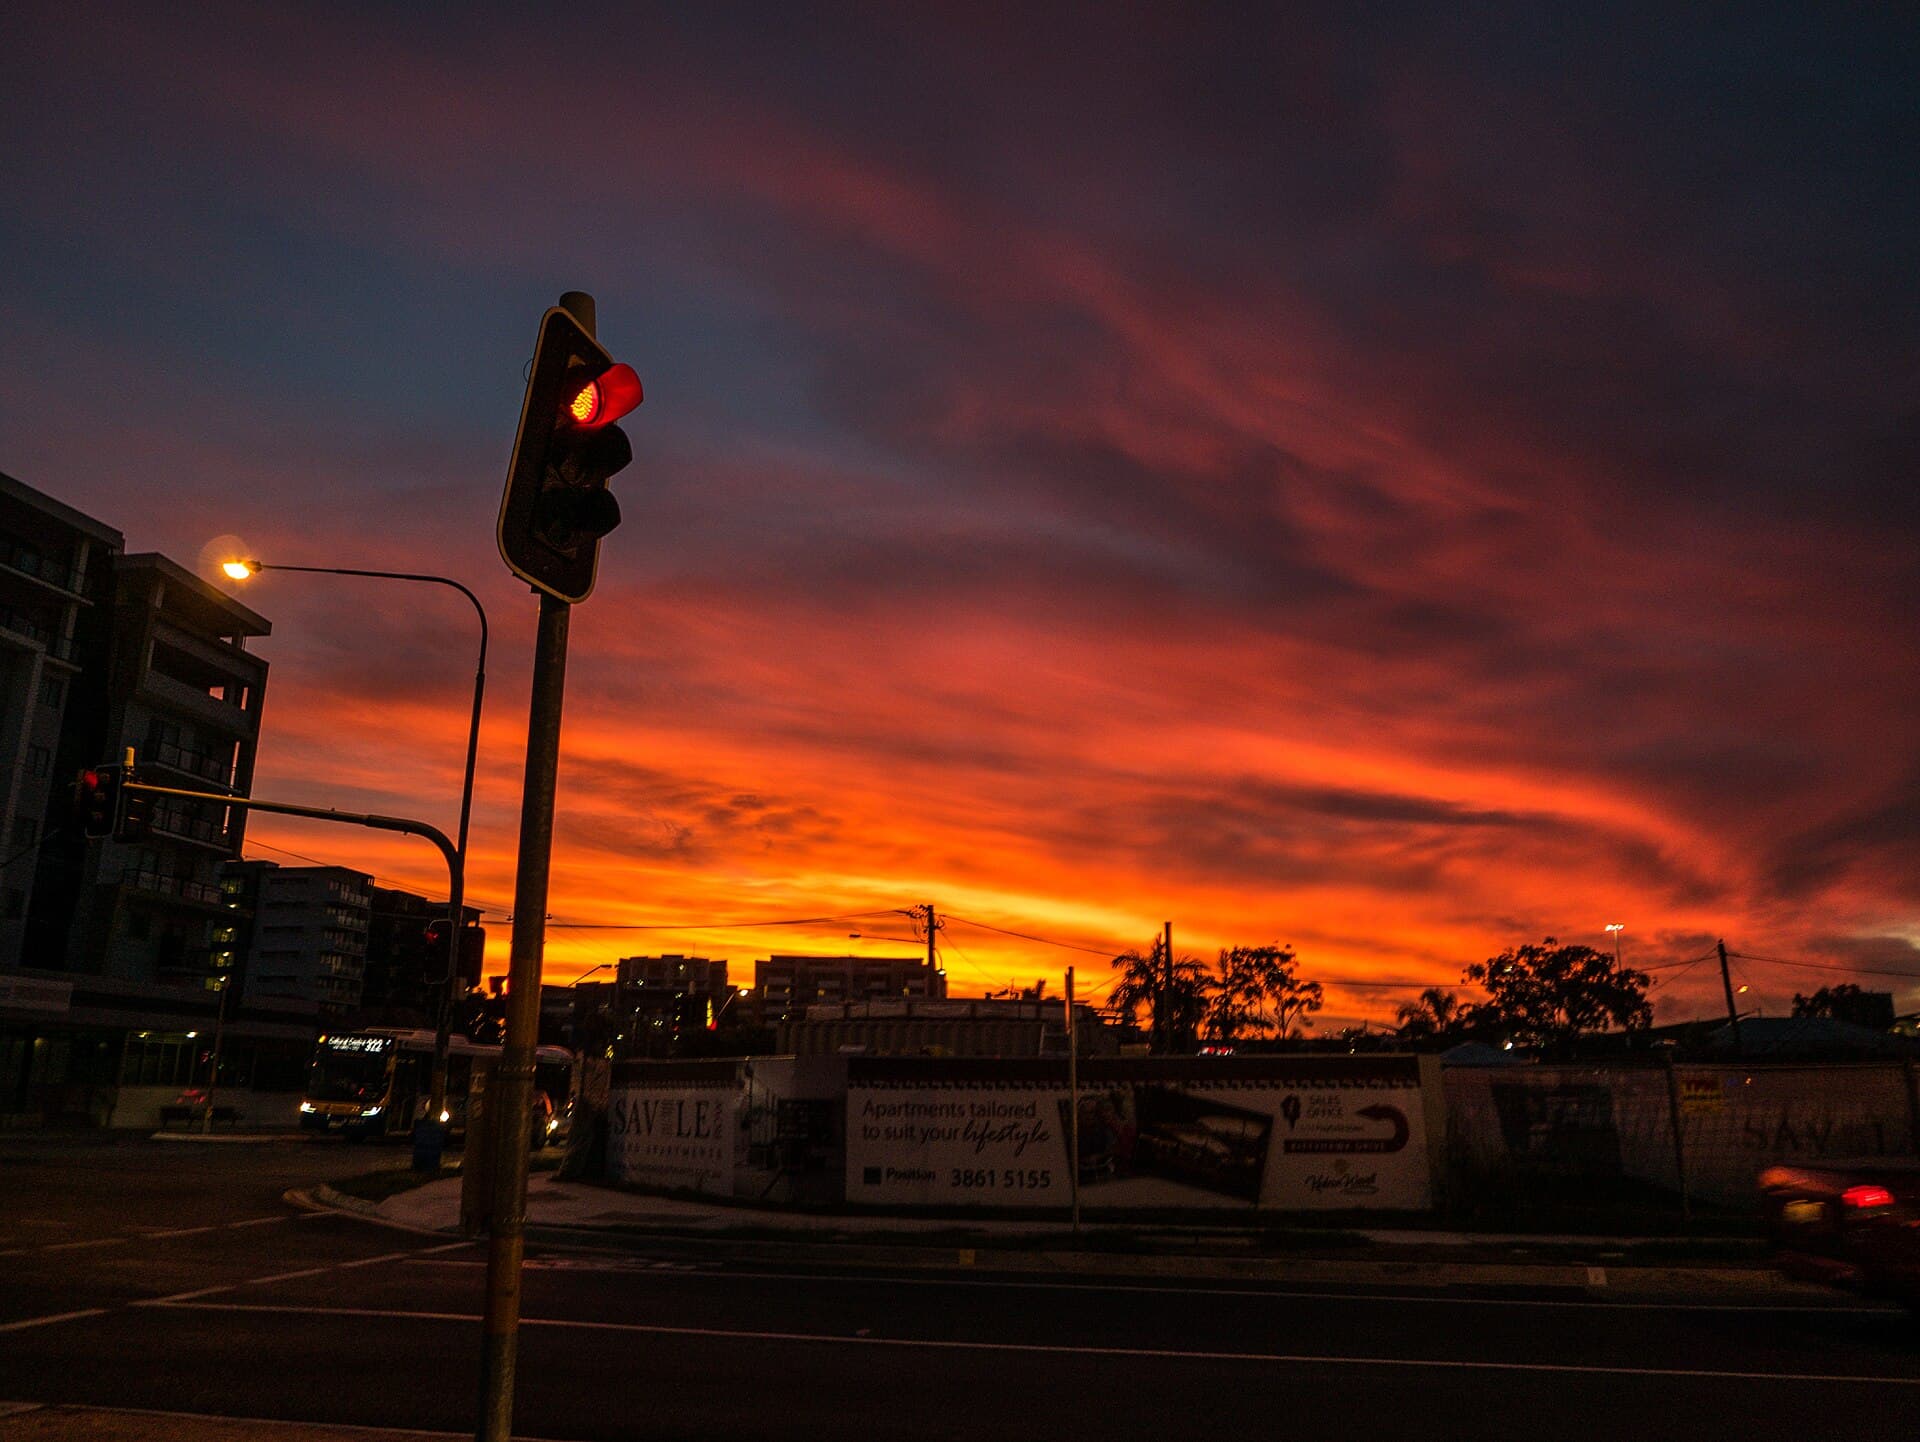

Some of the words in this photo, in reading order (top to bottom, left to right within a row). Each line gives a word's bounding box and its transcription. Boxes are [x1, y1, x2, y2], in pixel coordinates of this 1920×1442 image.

[862, 1099, 965, 1120] Apartments
[970, 1100, 1037, 1118] tailored
[863, 1123, 881, 1140] to
[885, 1124, 916, 1140] suit
[921, 1127, 960, 1147] your
[962, 1119, 1051, 1157] lifestyle
[952, 1168, 996, 1187] 3861
[1003, 1169, 1051, 1189] 5155
